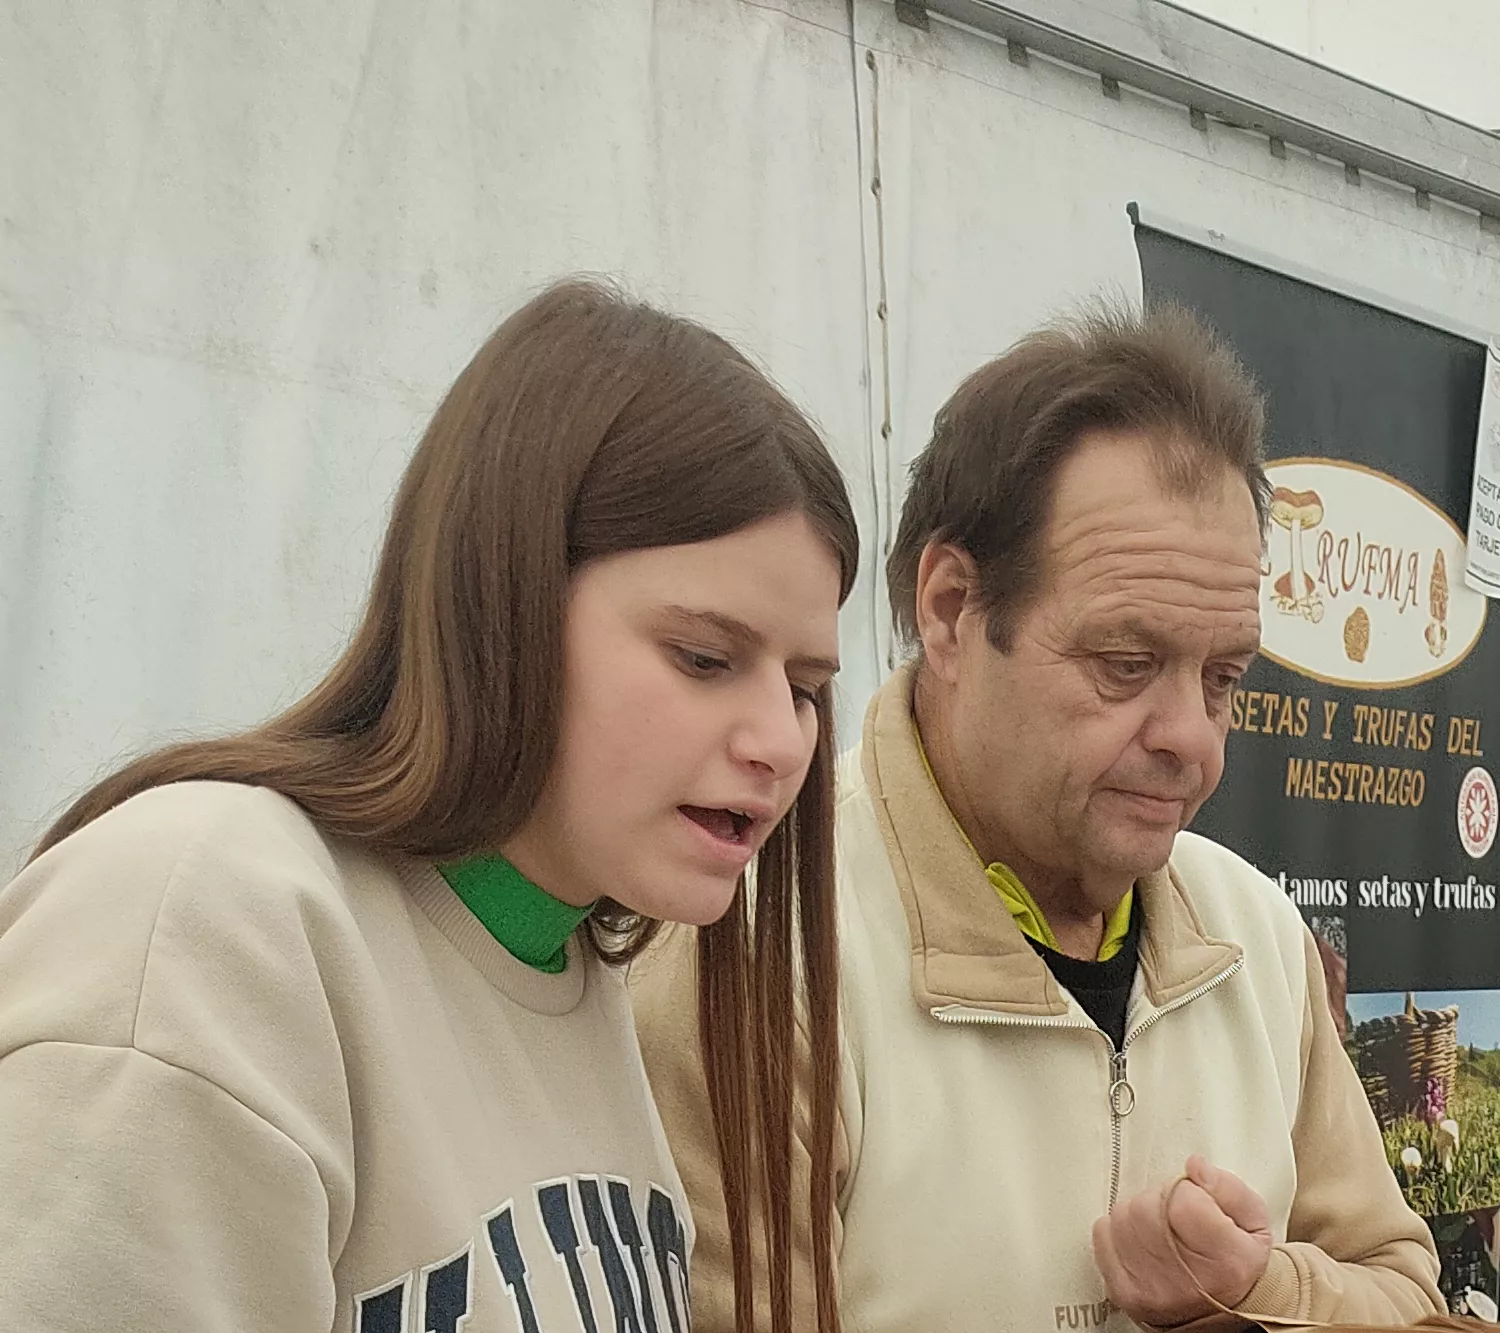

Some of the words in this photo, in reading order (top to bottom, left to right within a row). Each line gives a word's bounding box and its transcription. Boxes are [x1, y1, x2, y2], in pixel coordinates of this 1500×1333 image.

[1476, 502, 1495, 526] PAGO
[1230, 690, 1310, 738] SETAS
[1323, 701, 1339, 740] Y
[1353, 705, 1435, 751] TRUFAS
[1447, 717, 1484, 757] DEL
[1285, 757, 1426, 807] MAESTRAZGO
[1358, 875, 1412, 908] setas
[1414, 880, 1429, 917] y
[1434, 876, 1497, 911] trufas
